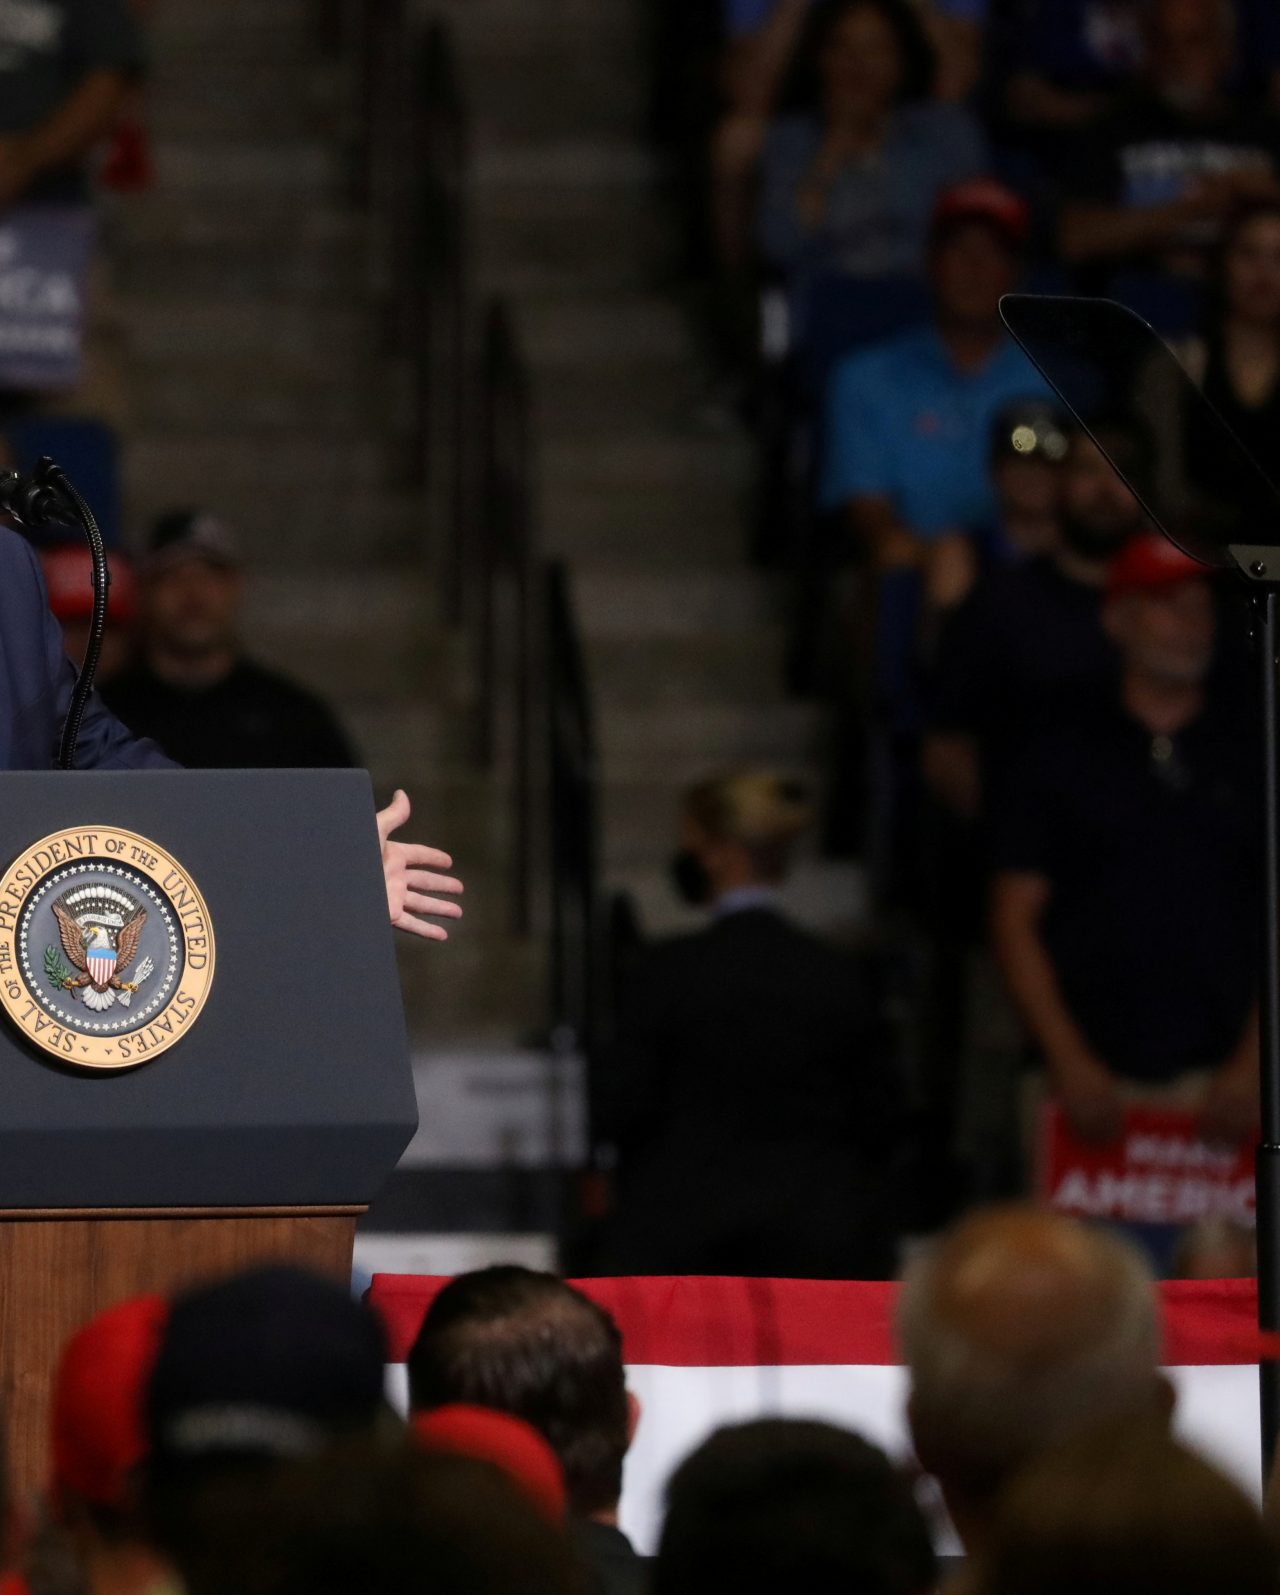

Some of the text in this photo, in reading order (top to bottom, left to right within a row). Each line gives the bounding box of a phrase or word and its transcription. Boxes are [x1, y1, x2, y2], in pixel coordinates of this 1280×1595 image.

[104, 838, 127, 854] OF
[130, 845, 159, 871] THE
[162, 869, 207, 970] UNITED
[4, 978, 22, 1000] OF
[20, 999, 77, 1054] SEAL
[118, 991, 196, 1059] STATES
[1054, 1165, 1258, 1229] AMERIC
